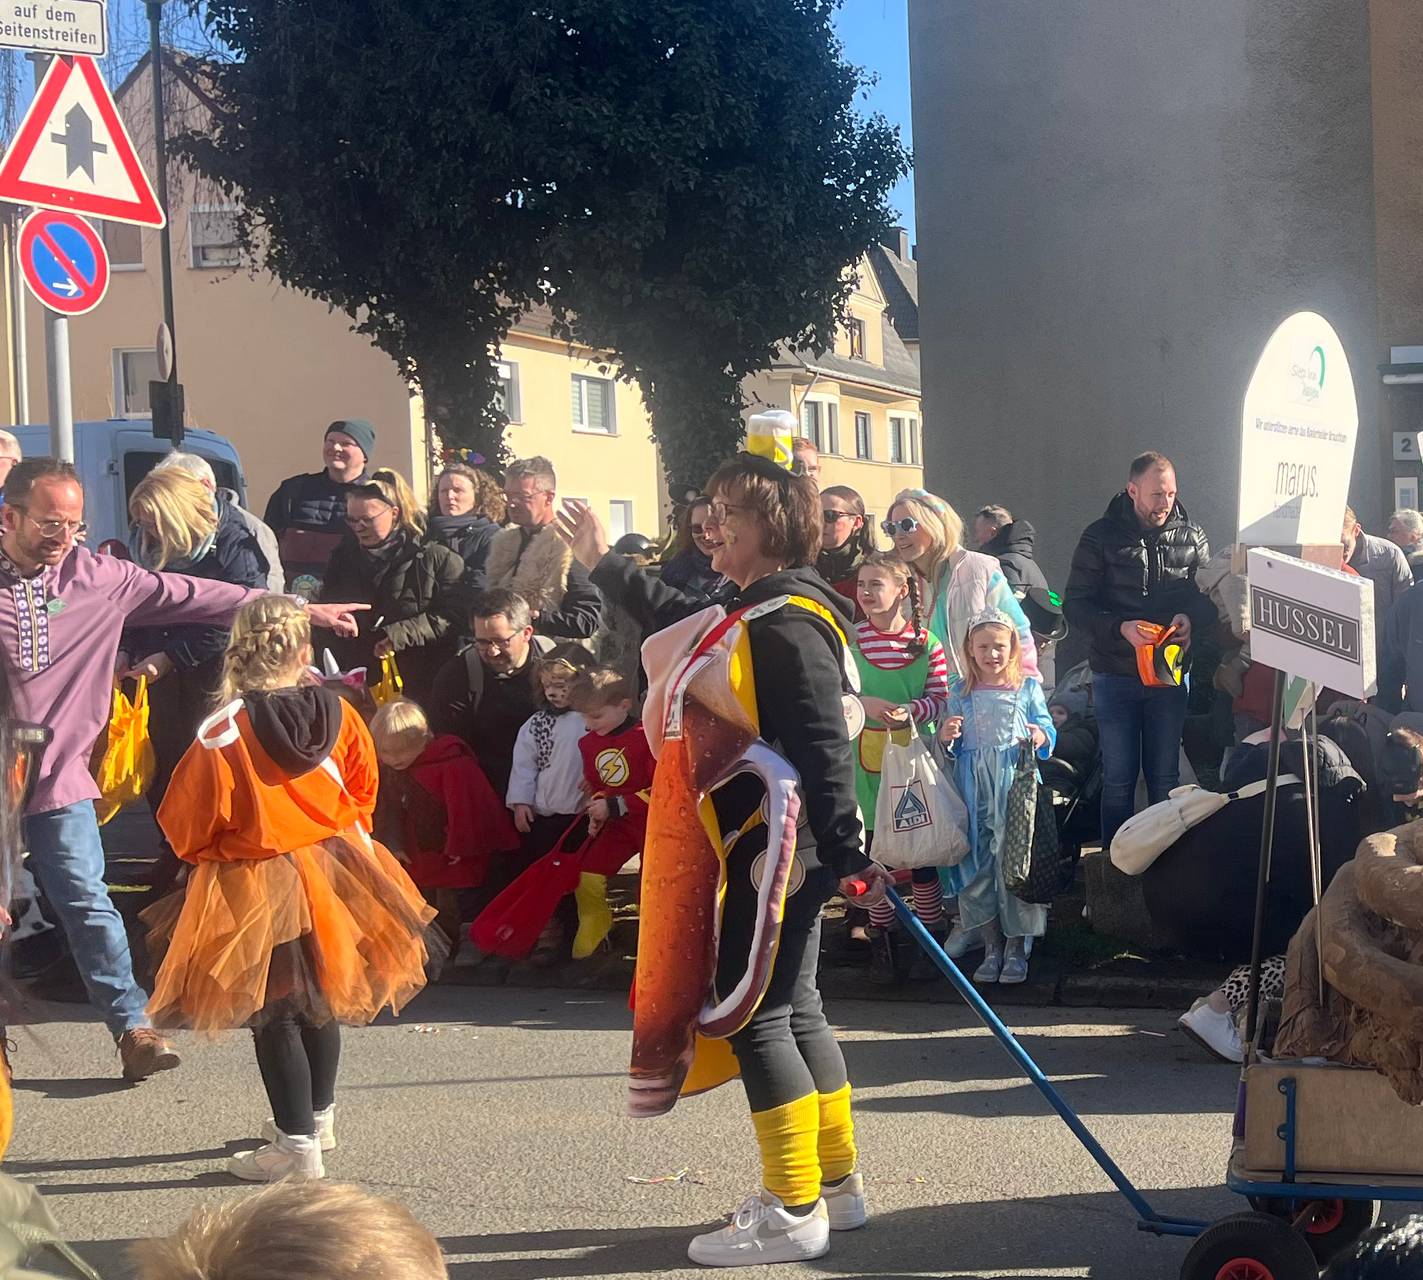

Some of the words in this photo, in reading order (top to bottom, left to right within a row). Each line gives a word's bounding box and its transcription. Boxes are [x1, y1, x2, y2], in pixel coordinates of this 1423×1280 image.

[14, 5, 38, 19] auf
[46, 6, 76, 23] dem
[1401, 438, 1412, 453] 2
[1259, 595, 1352, 653] HUSSEL
[898, 814, 926, 828] ALDI
